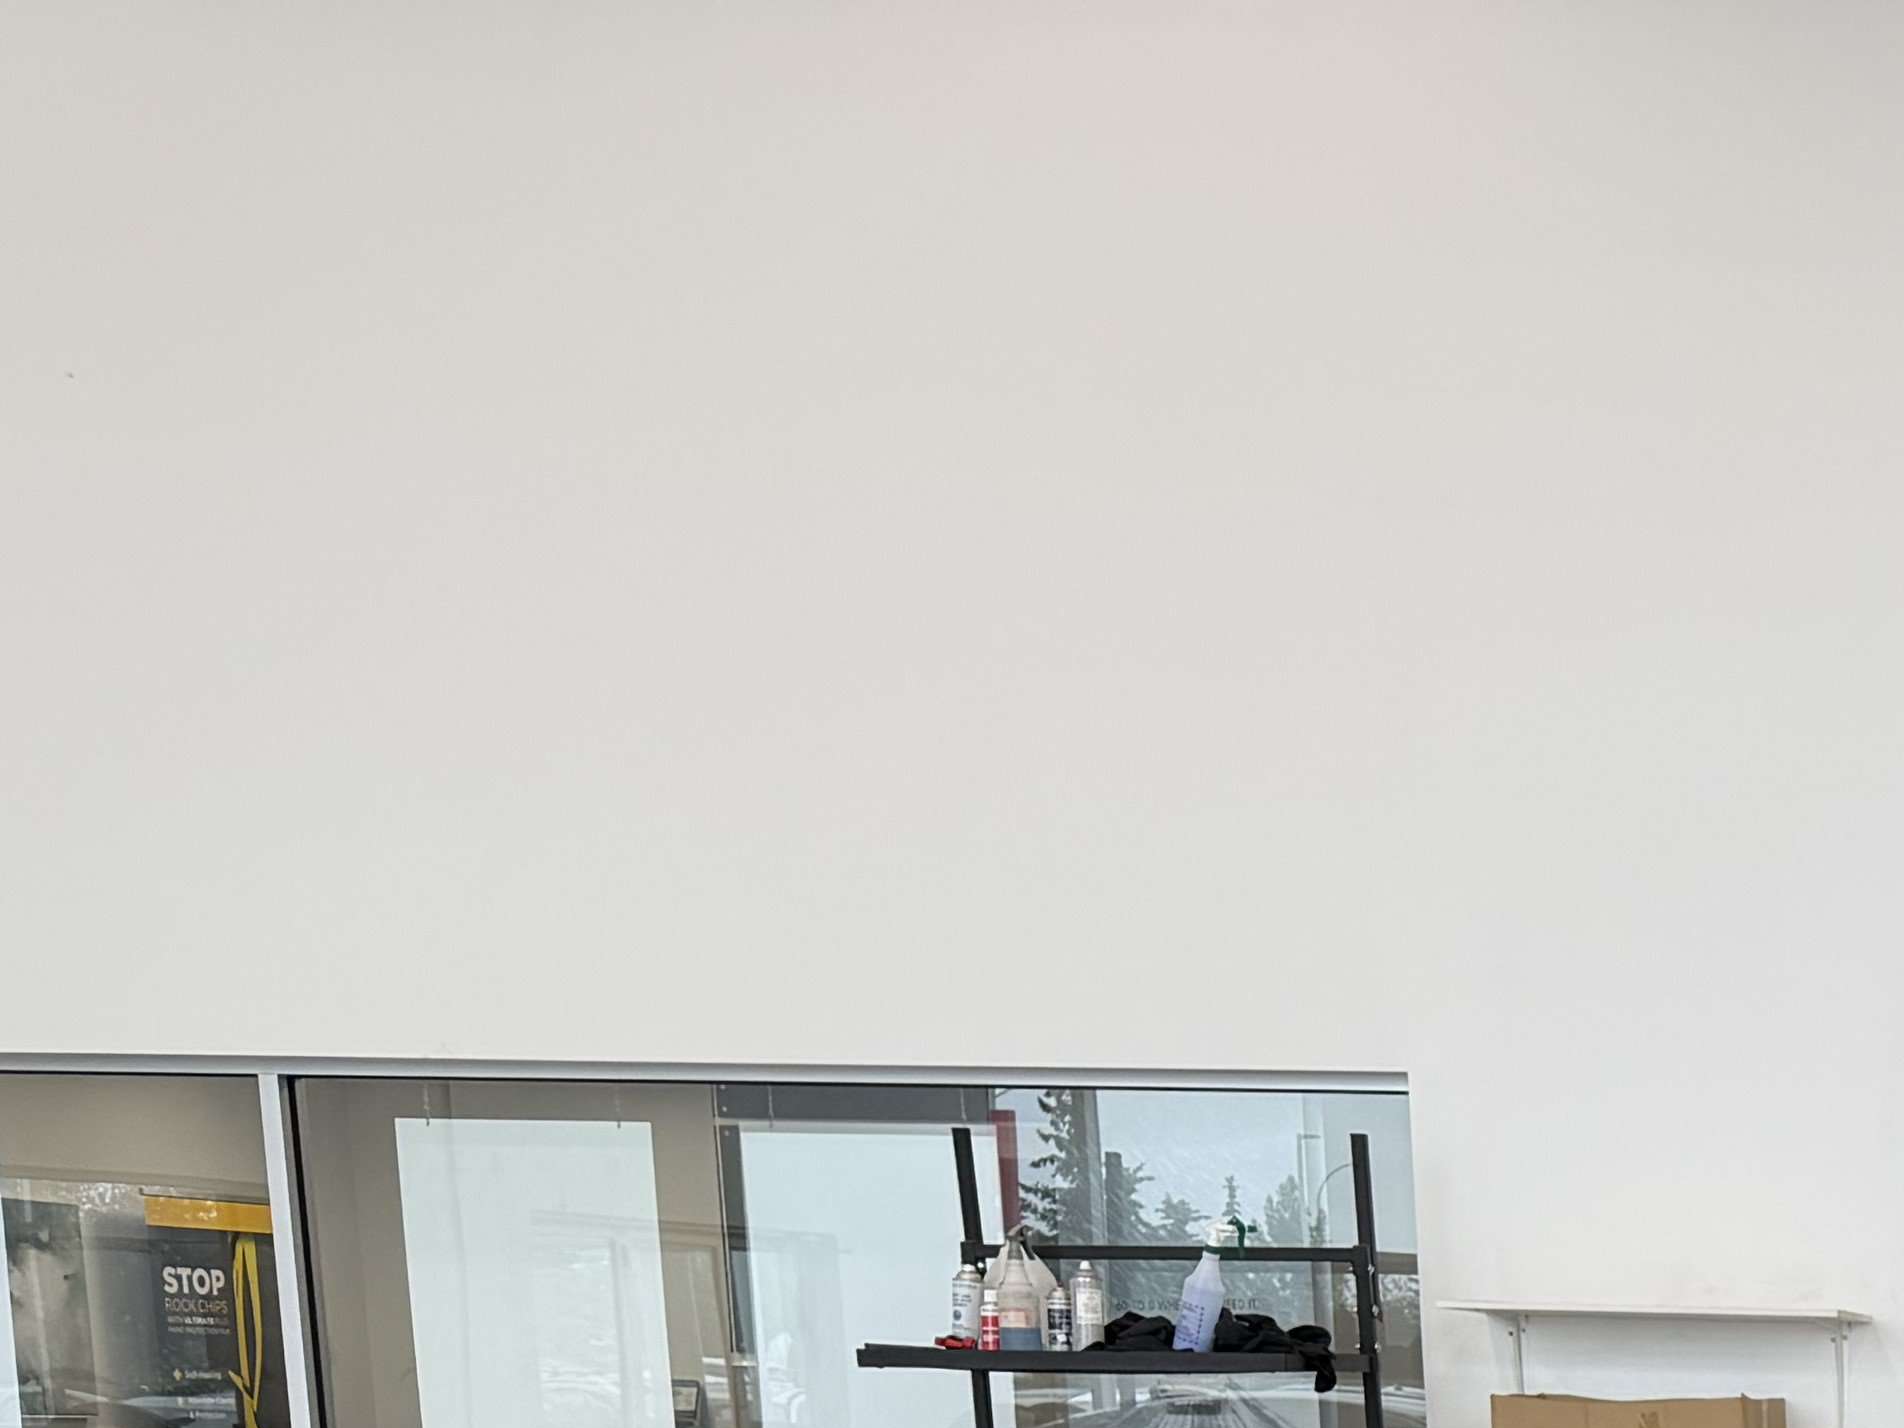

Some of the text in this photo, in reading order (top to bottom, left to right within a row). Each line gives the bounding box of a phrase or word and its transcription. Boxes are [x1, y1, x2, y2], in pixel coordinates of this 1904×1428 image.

[162, 1266, 225, 1295] STOP
[165, 1297, 229, 1314] ROCK CHIPS
